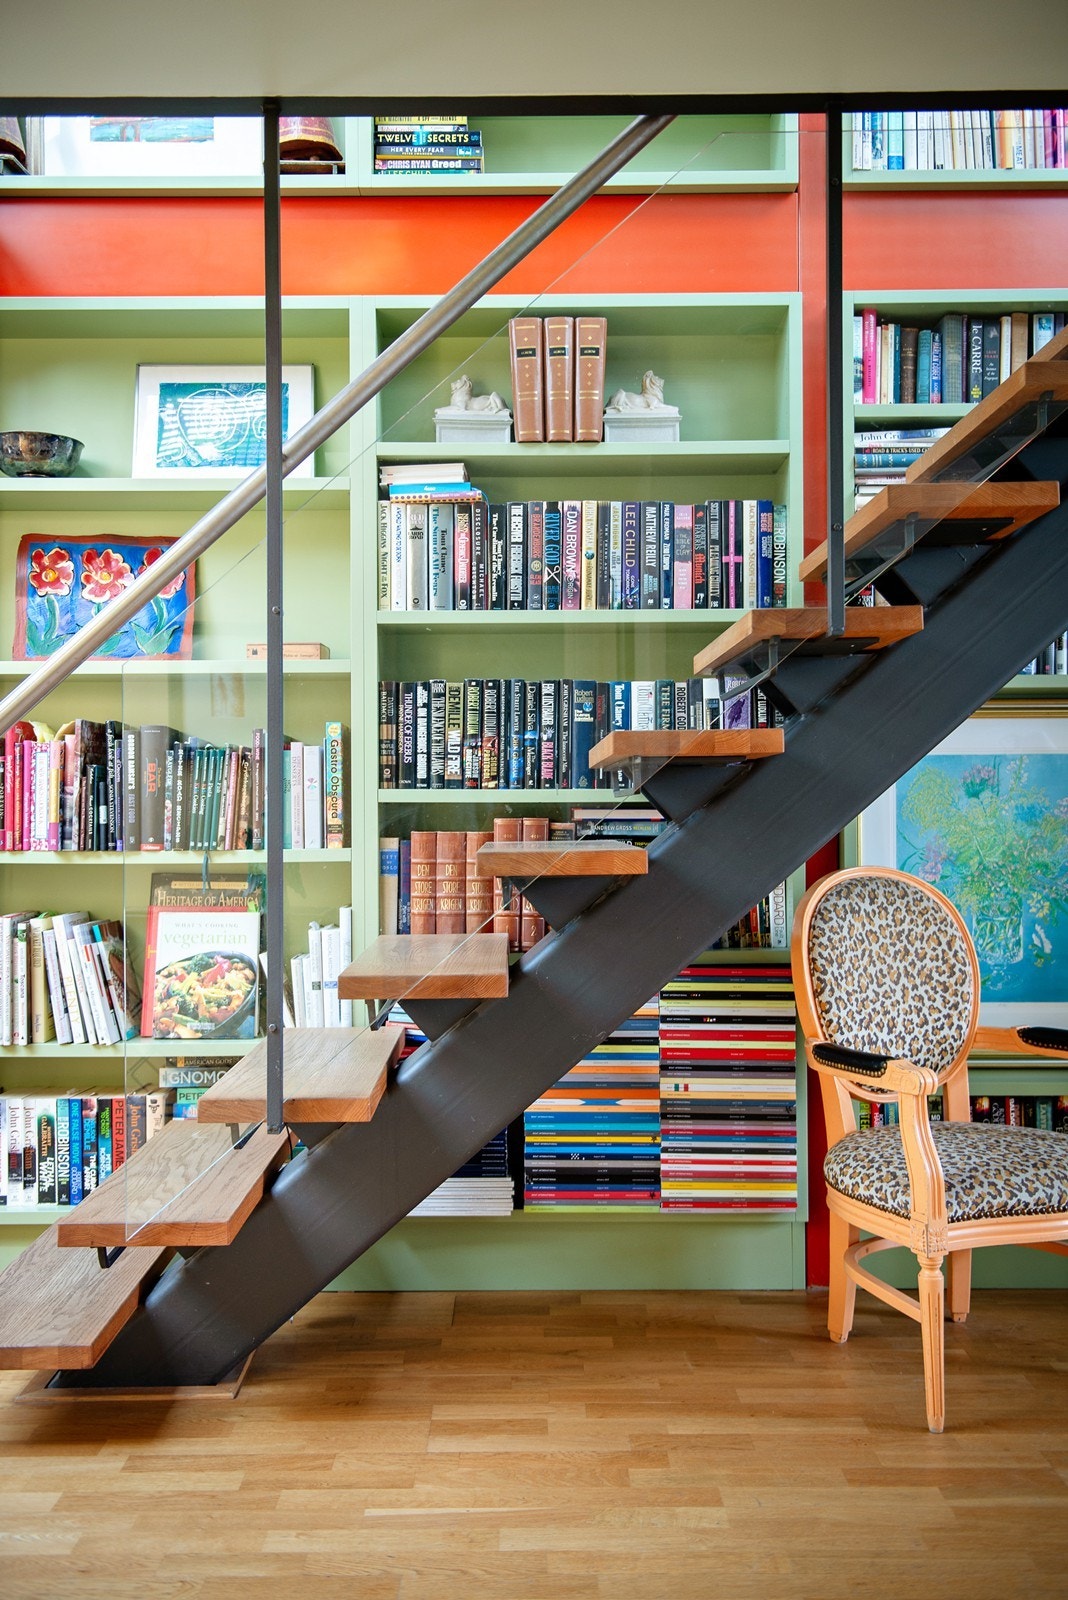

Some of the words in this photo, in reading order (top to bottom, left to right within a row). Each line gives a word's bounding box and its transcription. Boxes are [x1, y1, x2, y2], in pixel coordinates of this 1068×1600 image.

[378, 134, 418, 142] TWELVE
[427, 134, 468, 142] SECRETS
[387, 160, 410, 168] CHRIS
[411, 160, 430, 168] RYAN
[432, 160, 461, 168] Greed
[972, 325, 982, 333] le
[972, 336, 982, 373] CARRÉ
[860, 434, 882, 442] John
[566, 511, 577, 532] DAN
[625, 505, 635, 526] LEE
[711, 502, 719, 519] SCOTT
[545, 513, 559, 540] RIVER
[646, 506, 656, 542] MATTHEW
[711, 520, 719, 540] TUROW
[532, 514, 540, 558] BRANDENBURG
[433, 546, 439, 555] of
[511, 544, 522, 574] FREDERICK
[545, 544, 559, 565] GOD
[566, 534, 577, 572] BROWN
[625, 530, 635, 567] CHILD
[646, 544, 656, 567] REILLY
[774, 528, 786, 583] ROBINSON
[439, 547, 447, 574] Clancy
[695, 553, 706, 584] Munich
[467, 687, 479, 709] ROBERT
[528, 686, 536, 710] Daniel
[542, 683, 554, 695] ERIC
[615, 684, 624, 700] Tom
[662, 686, 670, 707] THE
[404, 692, 412, 724] THUNDER
[485, 689, 496, 712] ROBERT
[542, 696, 554, 725] LUSTBADER
[676, 687, 686, 714] ROBERT
[417, 708, 427, 717] ON
[467, 711, 479, 735] LUDLUM
[528, 713, 536, 731] Silva
[612, 701, 625, 727] Clancy
[662, 709, 670, 730] FIRM
[758, 701, 767, 723] LUDLUM
[404, 725, 412, 735] OF
[417, 718, 427, 753] DANGEROUS
[485, 714, 496, 738] LUDLUM
[404, 736, 412, 763] EREBUS
[448, 730, 460, 752] WILD
[542, 742, 553, 760] BLACK
[331, 739, 339, 774] Gastro
[417, 754, 427, 778] GROUND
[448, 755, 460, 775] FIRE
[526, 747, 535, 776] Messenger
[148, 763, 156, 792] BAR
[542, 762, 553, 779] BLADE
[331, 776, 339, 819] Obscura
[417, 864, 429, 876] DEN
[445, 864, 458, 876] DEN
[158, 891, 203, 906] HERITAGE
[204, 896, 216, 906] OF
[219, 892, 258, 906] AMERICA
[415, 881, 432, 894] STORE
[443, 881, 460, 894] STORE
[413, 899, 434, 911] KRIGEN
[440, 899, 462, 911] KRIGEN
[163, 930, 247, 948] vegetarian
[64, 976, 80, 1024] PLENTY
[169, 1072, 226, 1084] GNOMO
[8, 1106, 20, 1128] John
[24, 1106, 34, 1128] John
[114, 1101, 124, 1135] PETER
[130, 1104, 141, 1127] John
[10, 1130, 21, 1169] Grisham
[25, 1130, 35, 1169] Grisham
[58, 1122, 70, 1177] ROBINSON
[39, 1162, 47, 1192] WHITE
